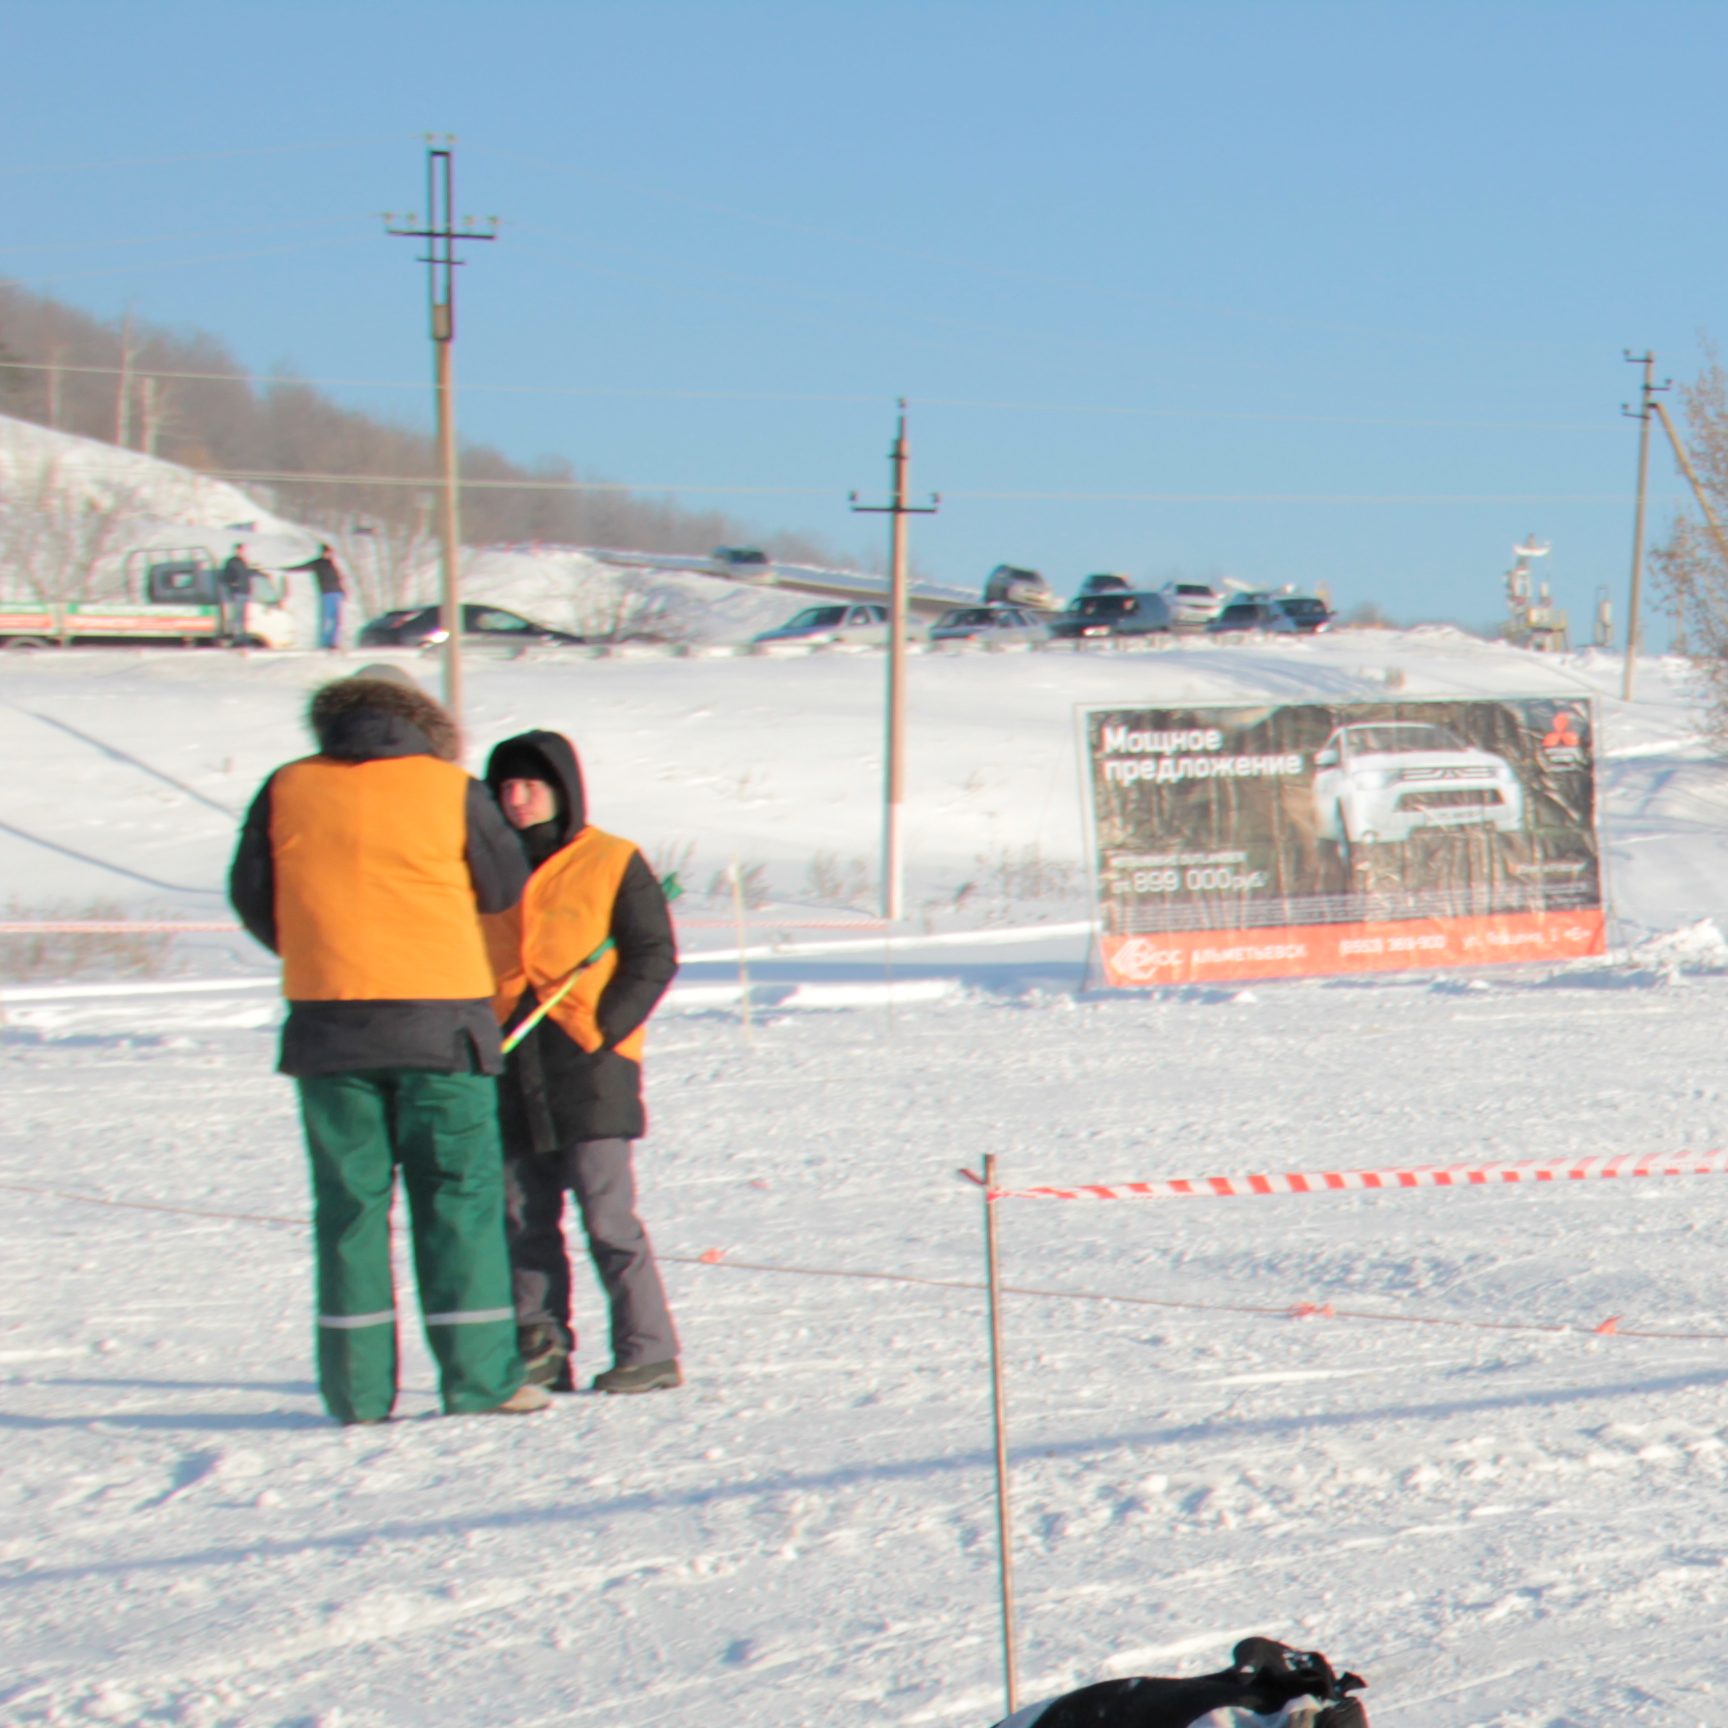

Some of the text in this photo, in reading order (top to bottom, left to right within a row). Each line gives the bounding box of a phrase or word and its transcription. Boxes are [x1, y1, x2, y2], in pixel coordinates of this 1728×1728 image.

[1103, 726, 1223, 754] Мощное
[1104, 754, 1304, 784] предложение
[1133, 870, 1180, 894] 899
[1185, 867, 1232, 891] 000
[1191, 943, 1308, 964] АЛЬМЕТЬЕВСК
